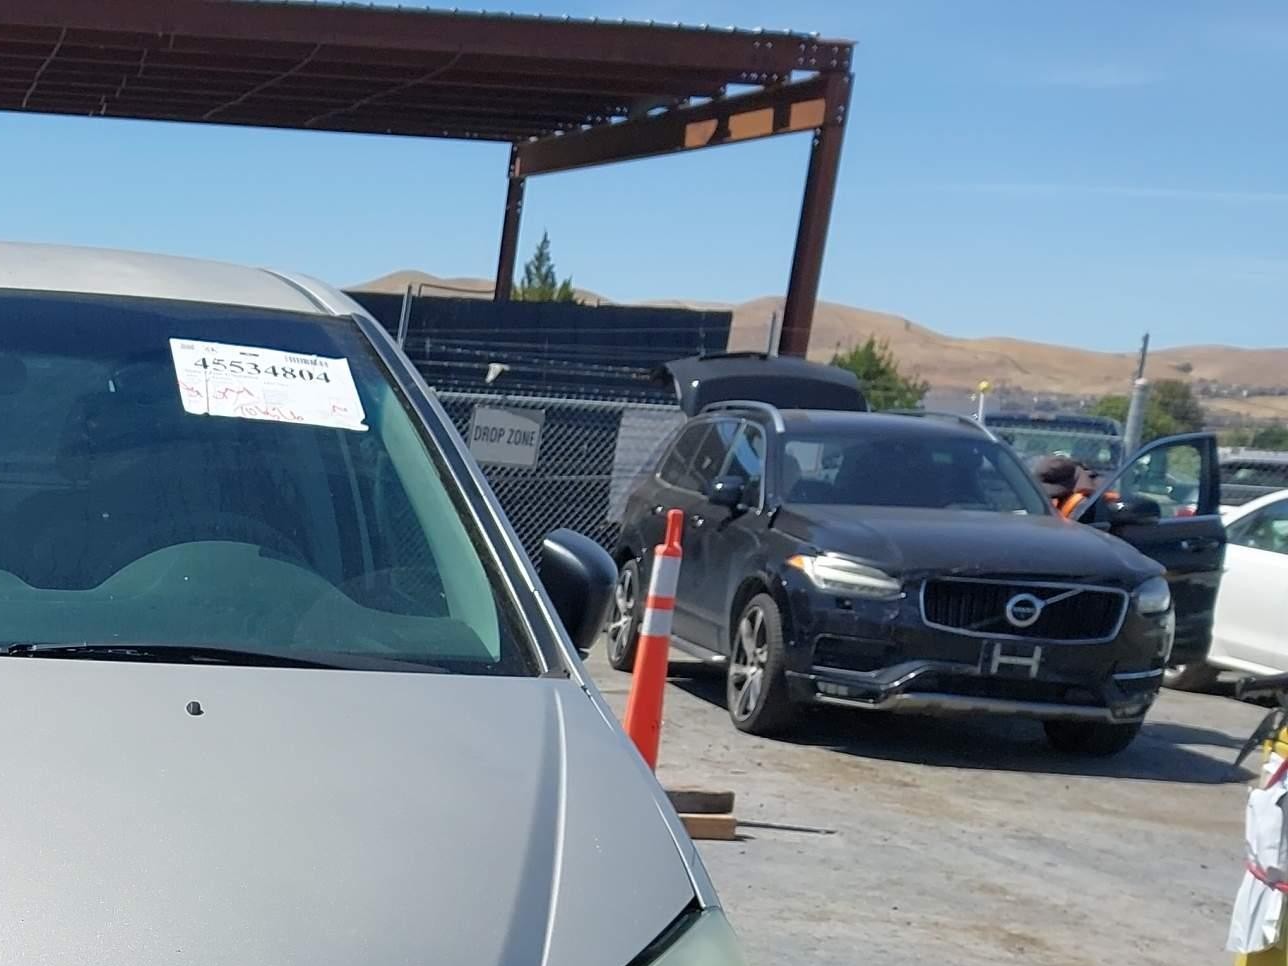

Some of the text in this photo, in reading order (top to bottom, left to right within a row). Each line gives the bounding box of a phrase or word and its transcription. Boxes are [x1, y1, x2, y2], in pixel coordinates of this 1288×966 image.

[193, 357, 331, 384] 45534804
[473, 425, 537, 447] DROP ZONE
